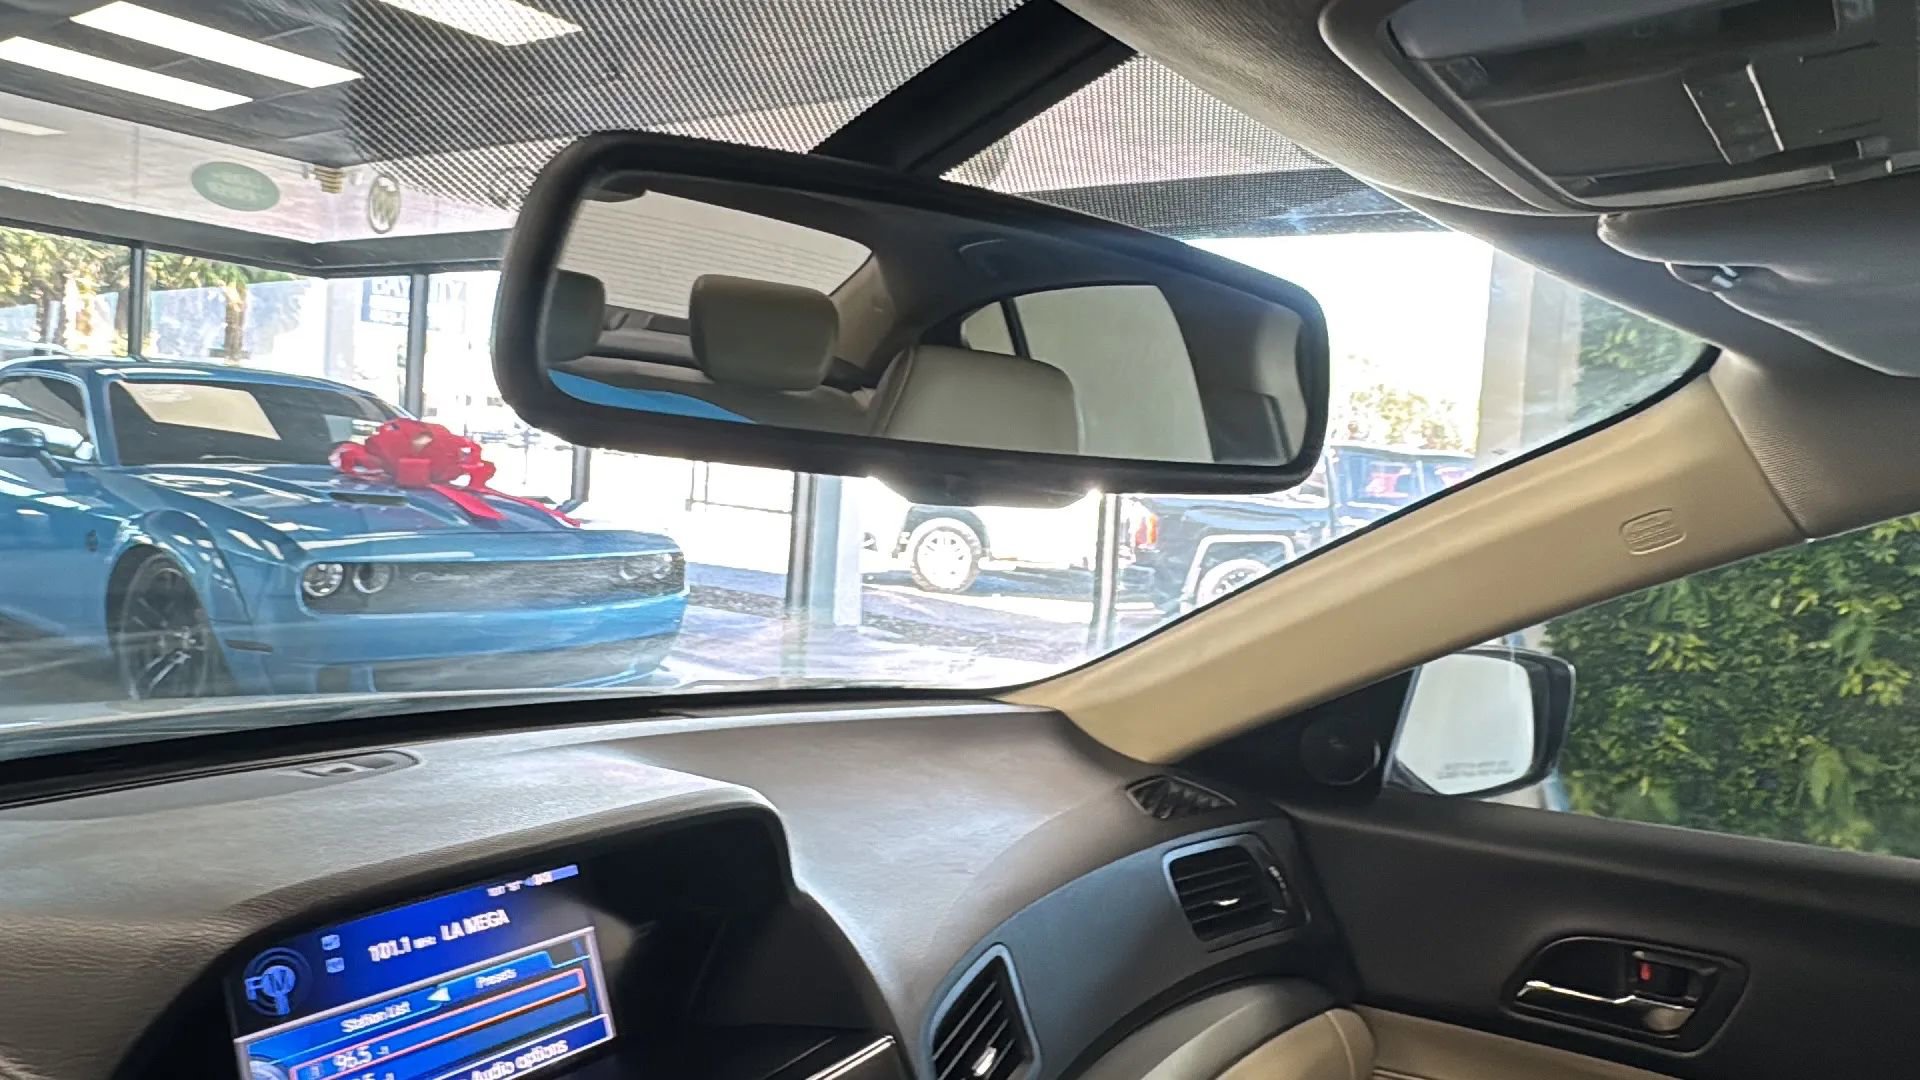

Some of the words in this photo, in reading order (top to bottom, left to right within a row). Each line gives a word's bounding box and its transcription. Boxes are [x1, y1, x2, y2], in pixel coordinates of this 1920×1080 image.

[440, 921, 465, 941] LA
[462, 909, 510, 934] MEGA
[515, 1039, 569, 1070] options
